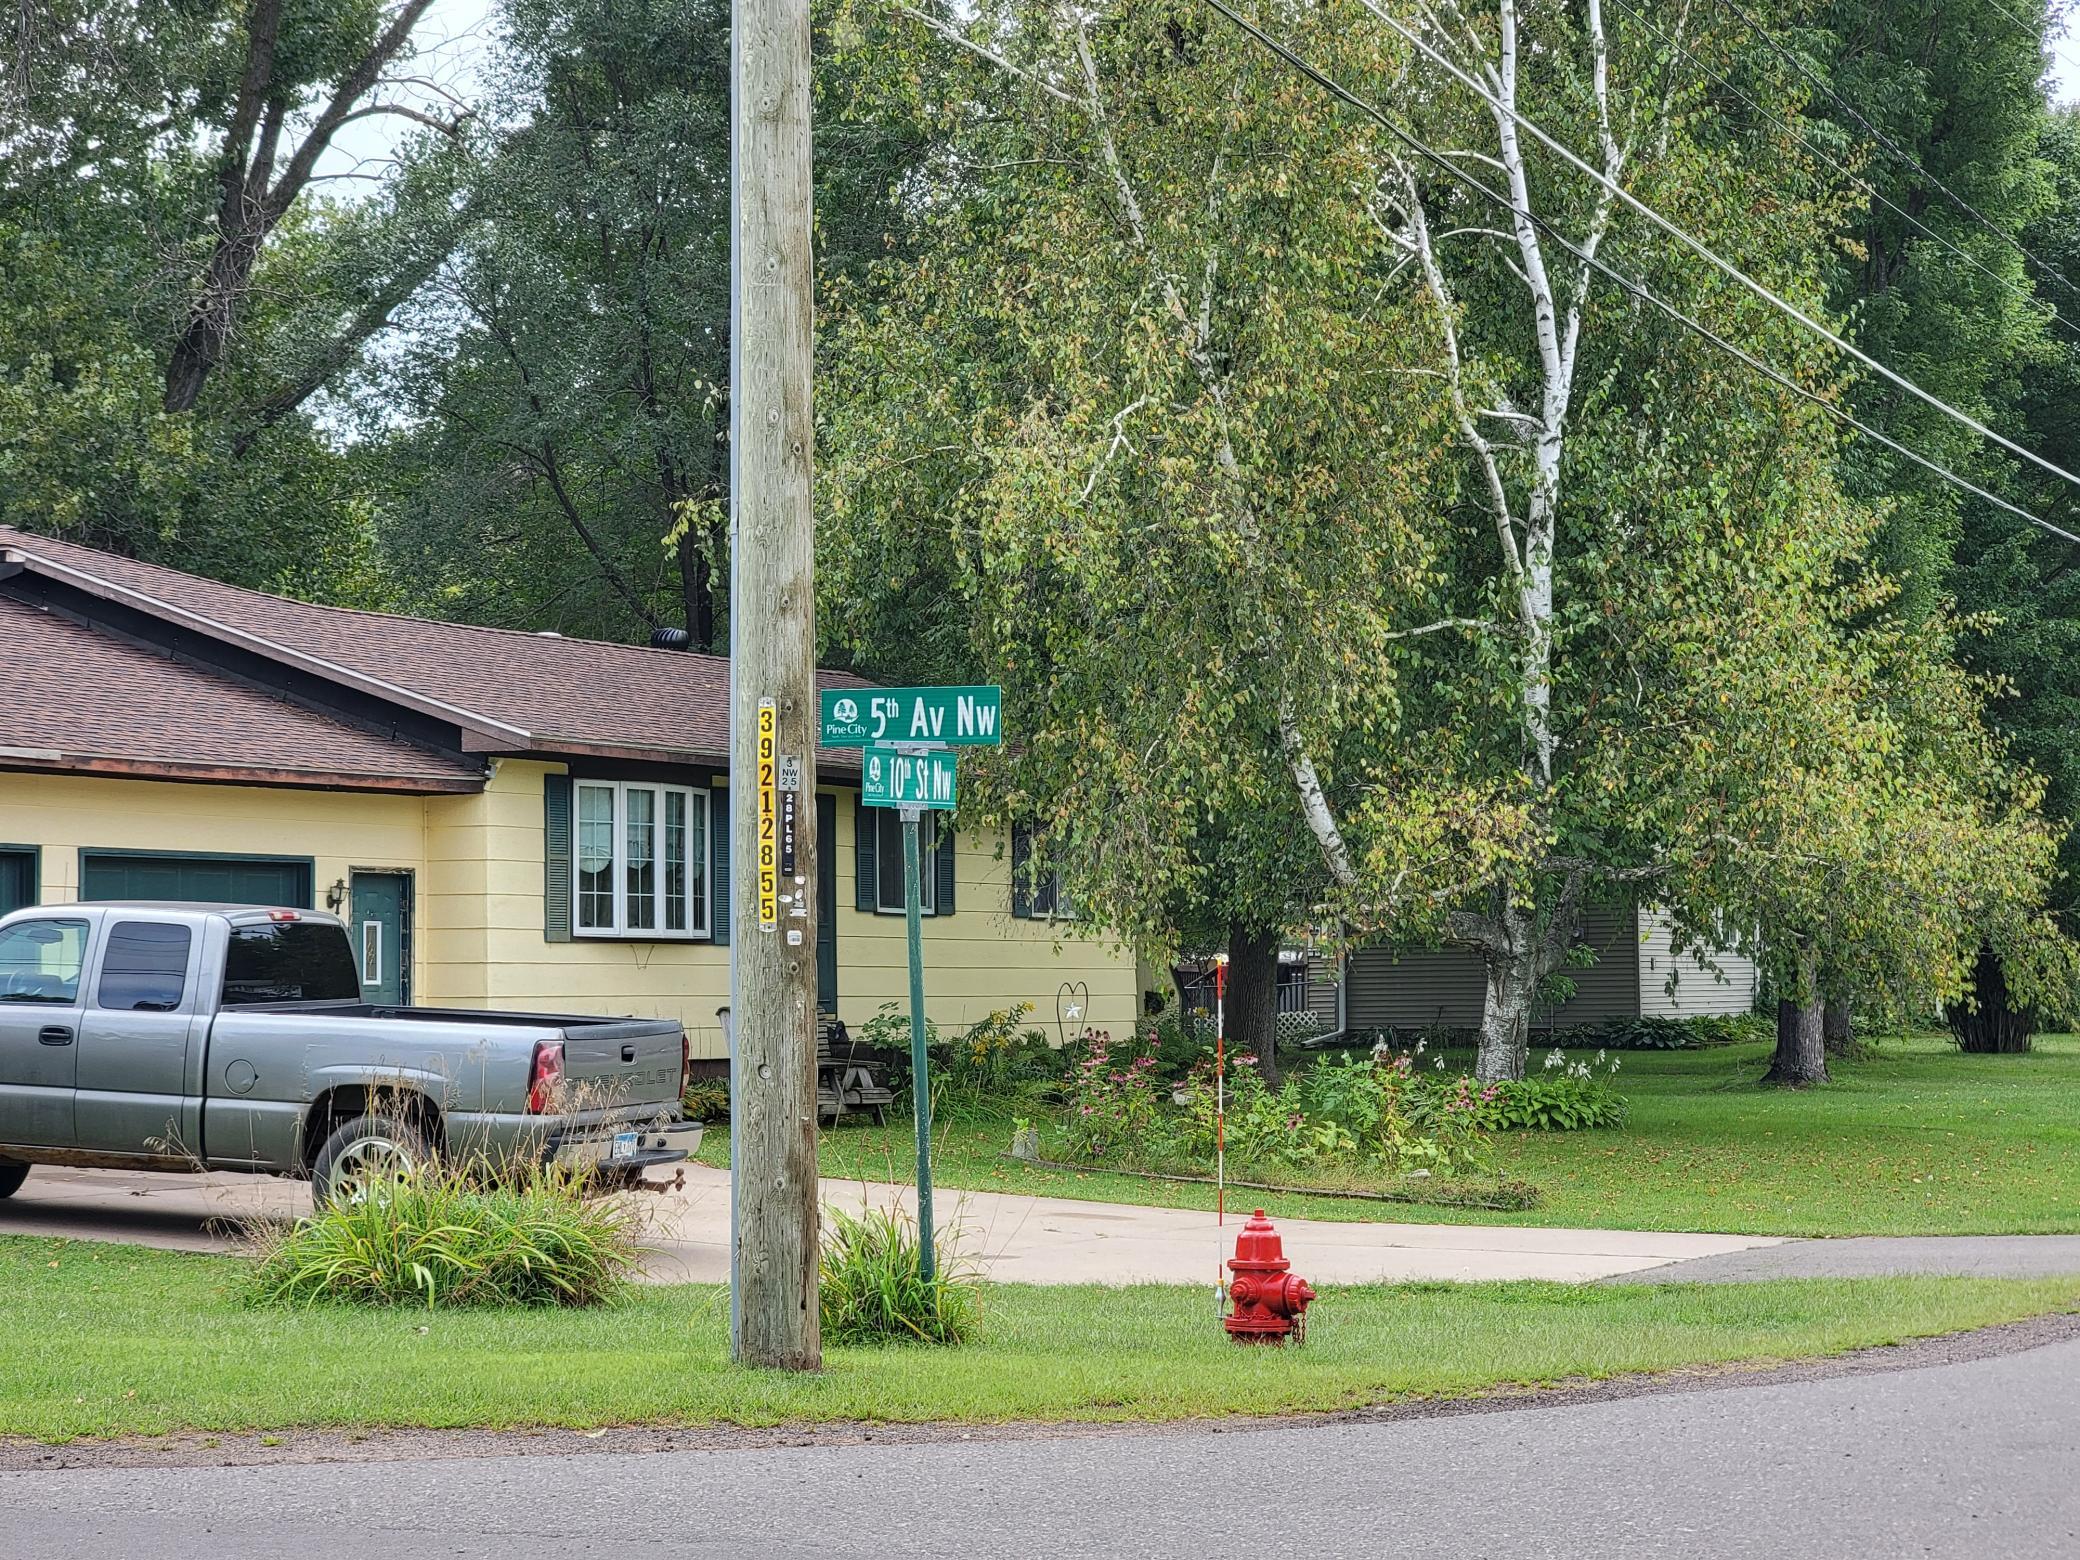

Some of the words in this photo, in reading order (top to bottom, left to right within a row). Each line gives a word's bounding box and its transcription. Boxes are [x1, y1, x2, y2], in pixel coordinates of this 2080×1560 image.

[826, 724, 847, 735] Pine
[847, 723, 868, 737] City
[871, 697, 899, 739] 5th
[909, 696, 945, 738] Av
[957, 695, 996, 737] Nw
[782, 768, 798, 777] NW
[889, 757, 911, 799] 10th
[915, 758, 929, 801] St
[933, 759, 952, 801] Nw
